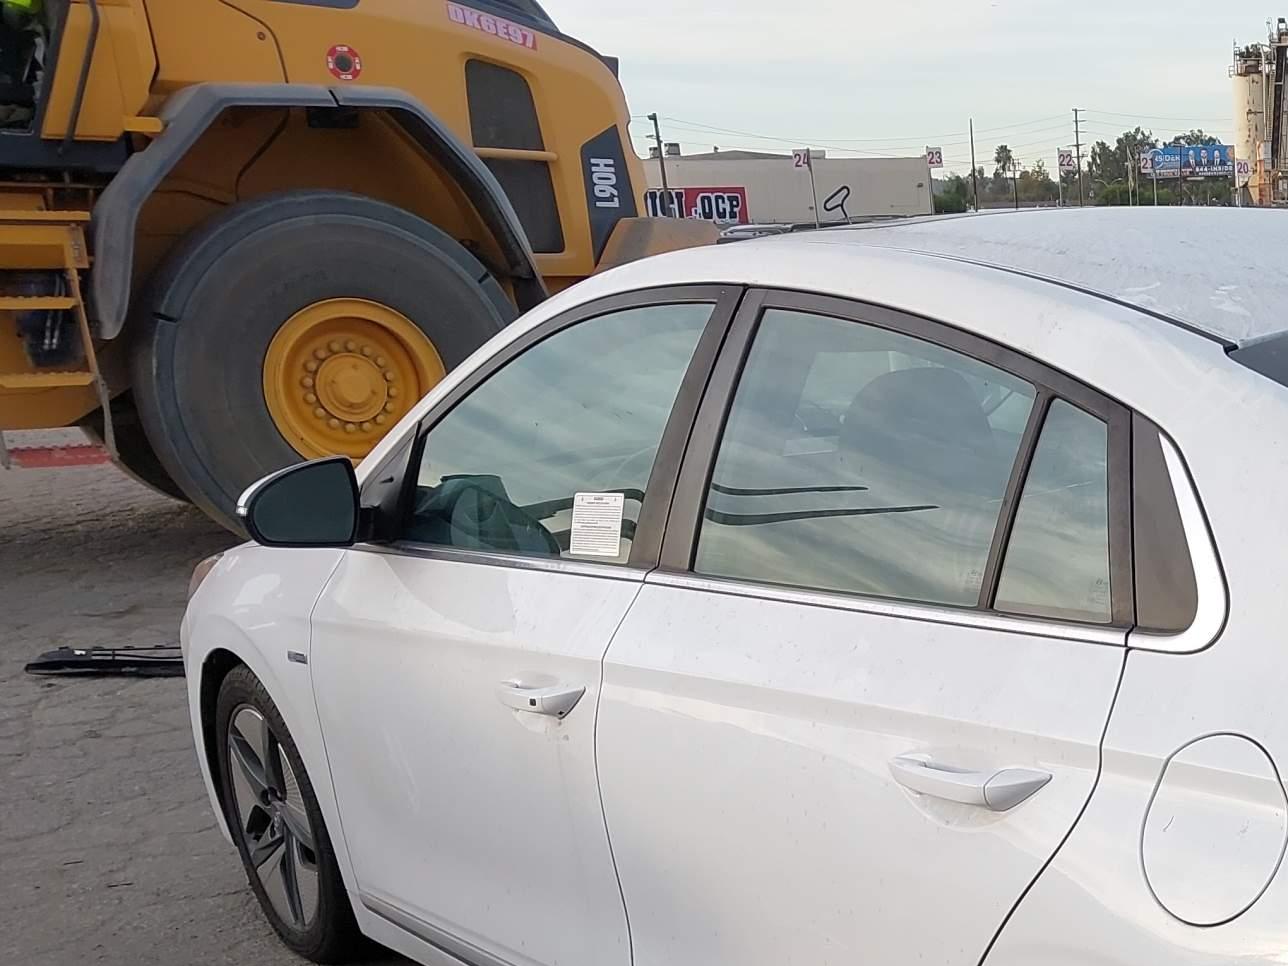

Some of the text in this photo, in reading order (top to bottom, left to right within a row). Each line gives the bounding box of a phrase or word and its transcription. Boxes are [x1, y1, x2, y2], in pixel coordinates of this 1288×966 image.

[448, 4, 535, 49] DK6E97
[794, 153, 810, 167] 24
[928, 151, 942, 164] 23
[1059, 153, 1072, 166] 22
[1237, 161, 1248, 174] 20
[590, 158, 620, 208] L90H
